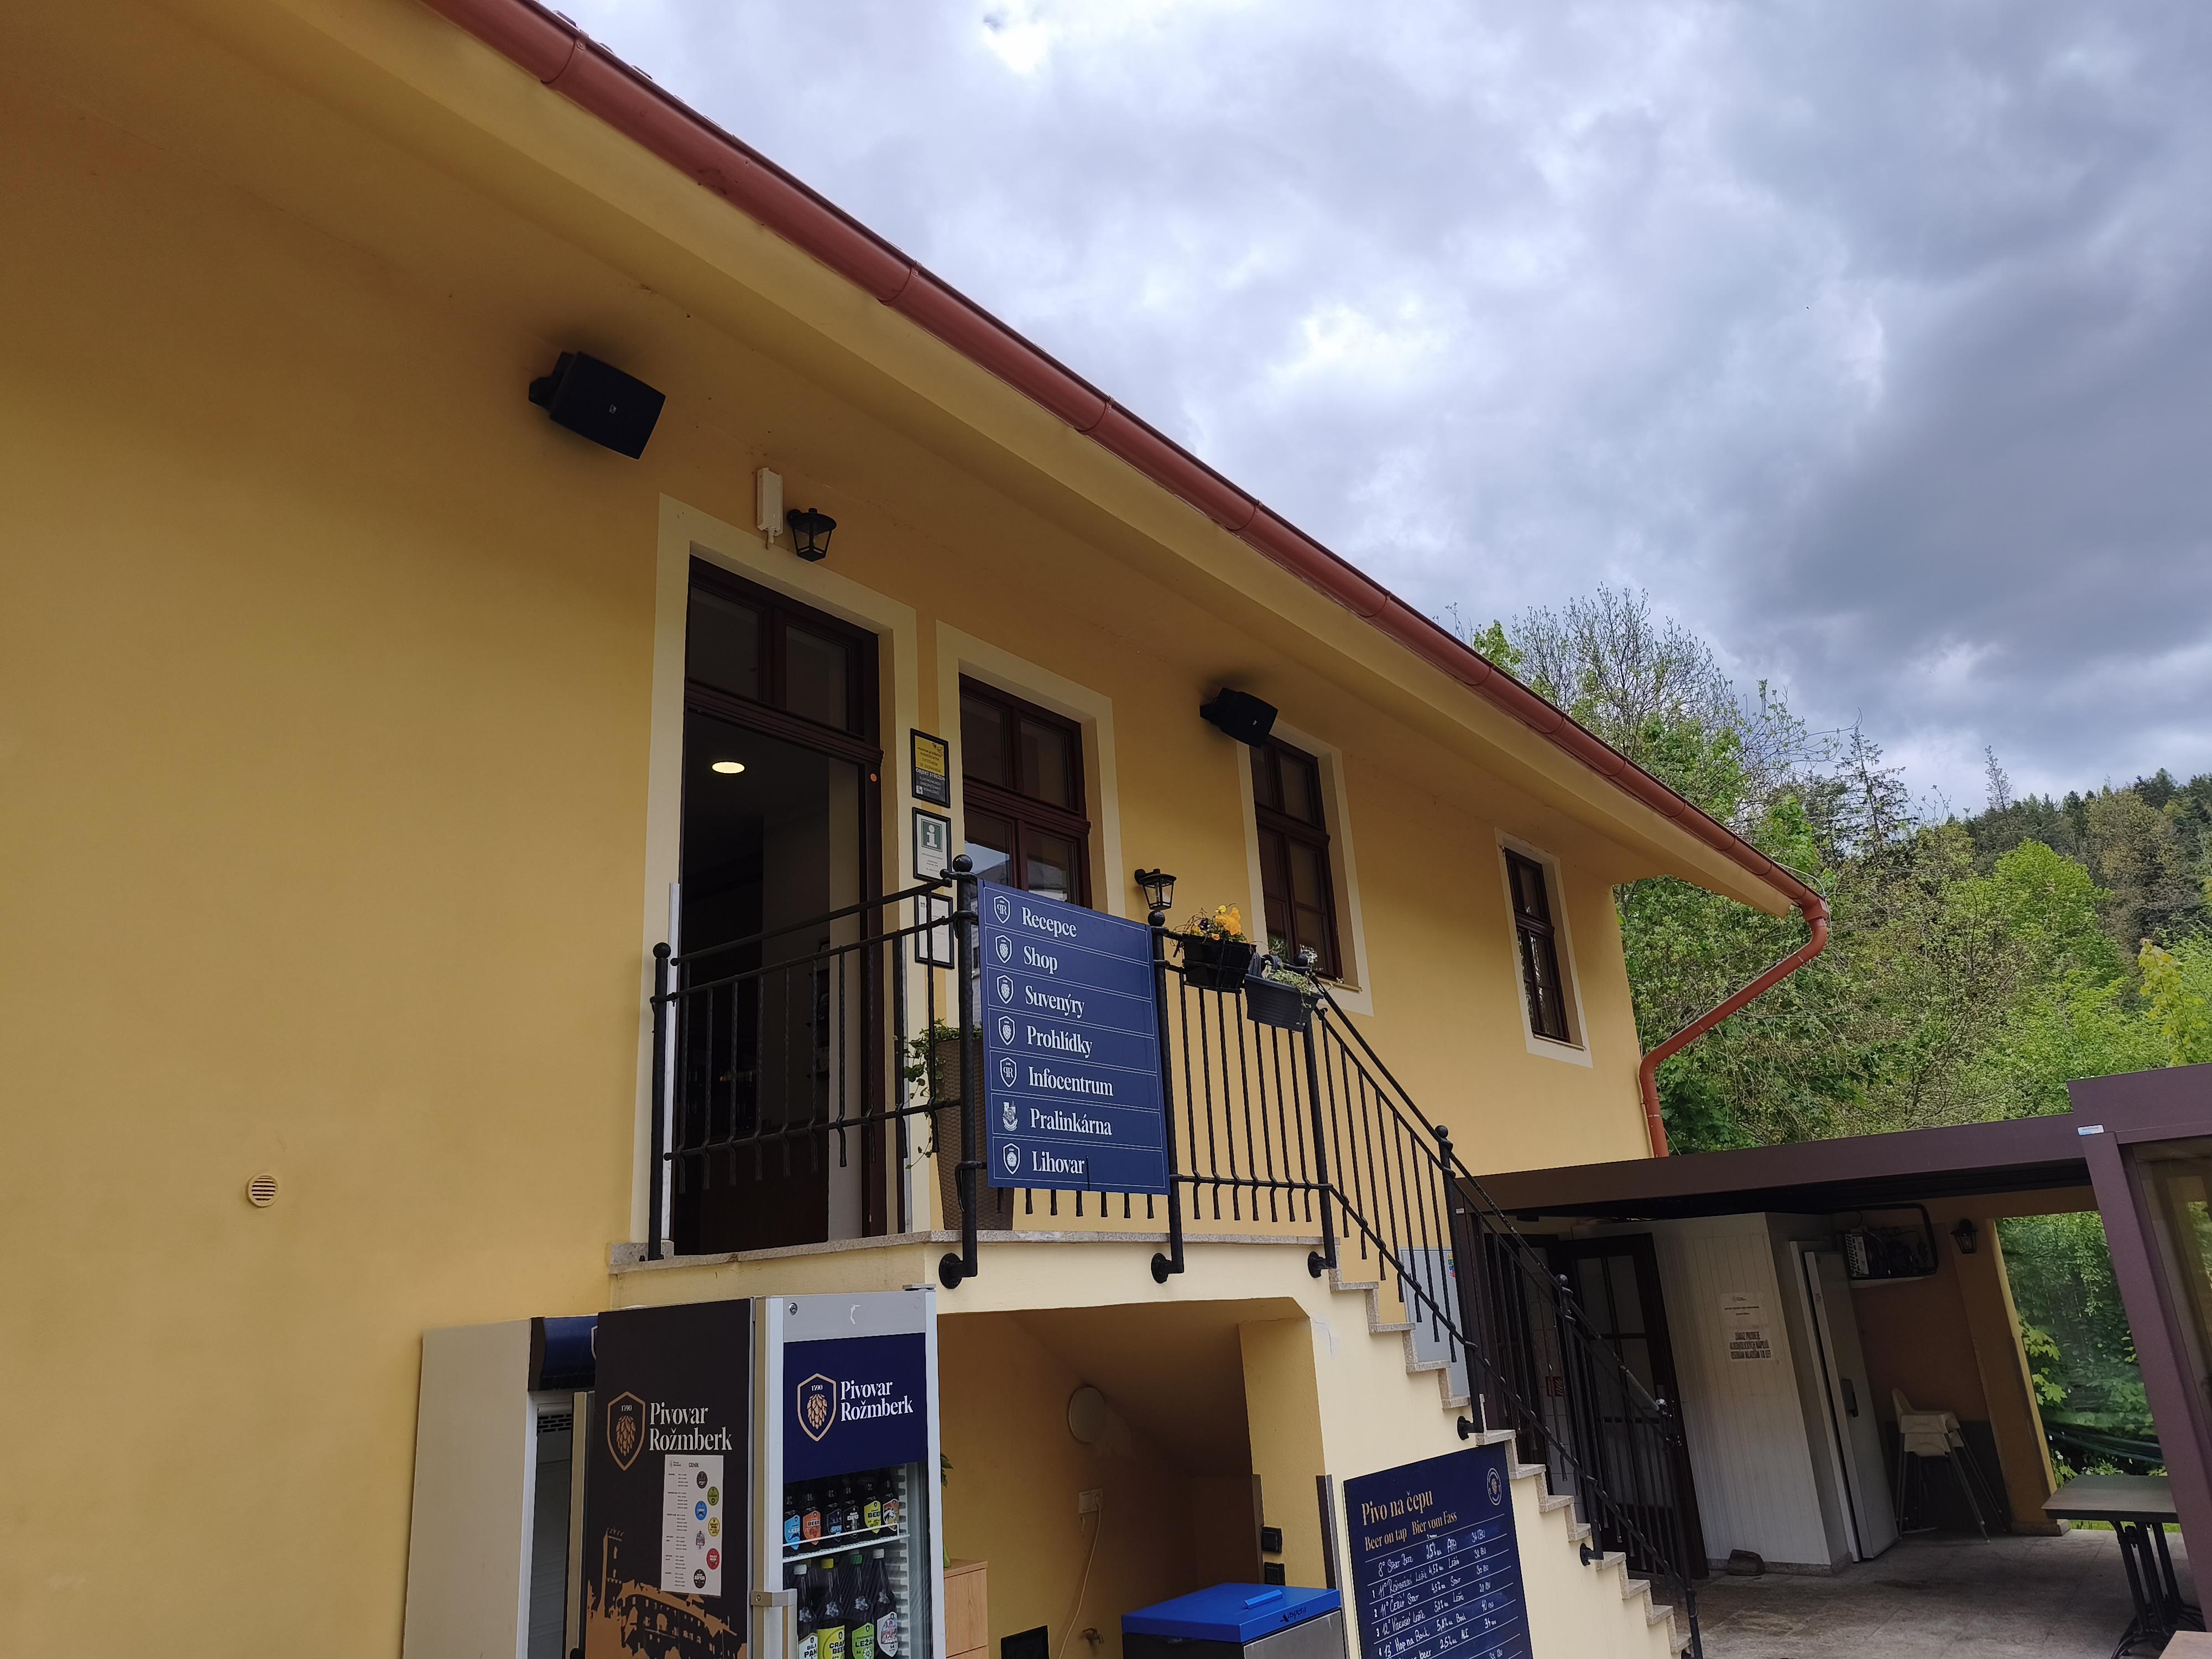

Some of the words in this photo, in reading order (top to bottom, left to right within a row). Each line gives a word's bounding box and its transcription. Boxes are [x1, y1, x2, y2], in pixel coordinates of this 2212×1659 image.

[1021, 906, 1077, 937] Recepce
[1023, 946, 1058, 974] Shop
[1025, 985, 1084, 1019] Suvenýry
[1026, 1025, 1092, 1058] Prohlídky
[1028, 1066, 1114, 1096] Infocentrum
[1030, 1108, 1113, 1136] Pralinkárna
[1032, 1150, 1085, 1175] Lihovar
[841, 1380, 893, 1400] Pivovar
[650, 1402, 708, 1425] Pivovar
[841, 1395, 913, 1422] Rožmberk
[649, 1426, 733, 1451] Rožmberk
[1361, 1501, 1387, 1526] Pivo
[1390, 1499, 1405, 1517] na
[1406, 1490, 1433, 1514] čepu
[1365, 1535, 1383, 1551] Beer
[1384, 1531, 1394, 1545] on
[1395, 1528, 1407, 1542] tap
[1412, 1520, 1426, 1535] Bier
[1428, 1517, 1443, 1530] vom
[1443, 1511, 1457, 1525] Fass
[1376, 1628, 1380, 1637] 3
[804, 1650, 817, 1658] PAN
